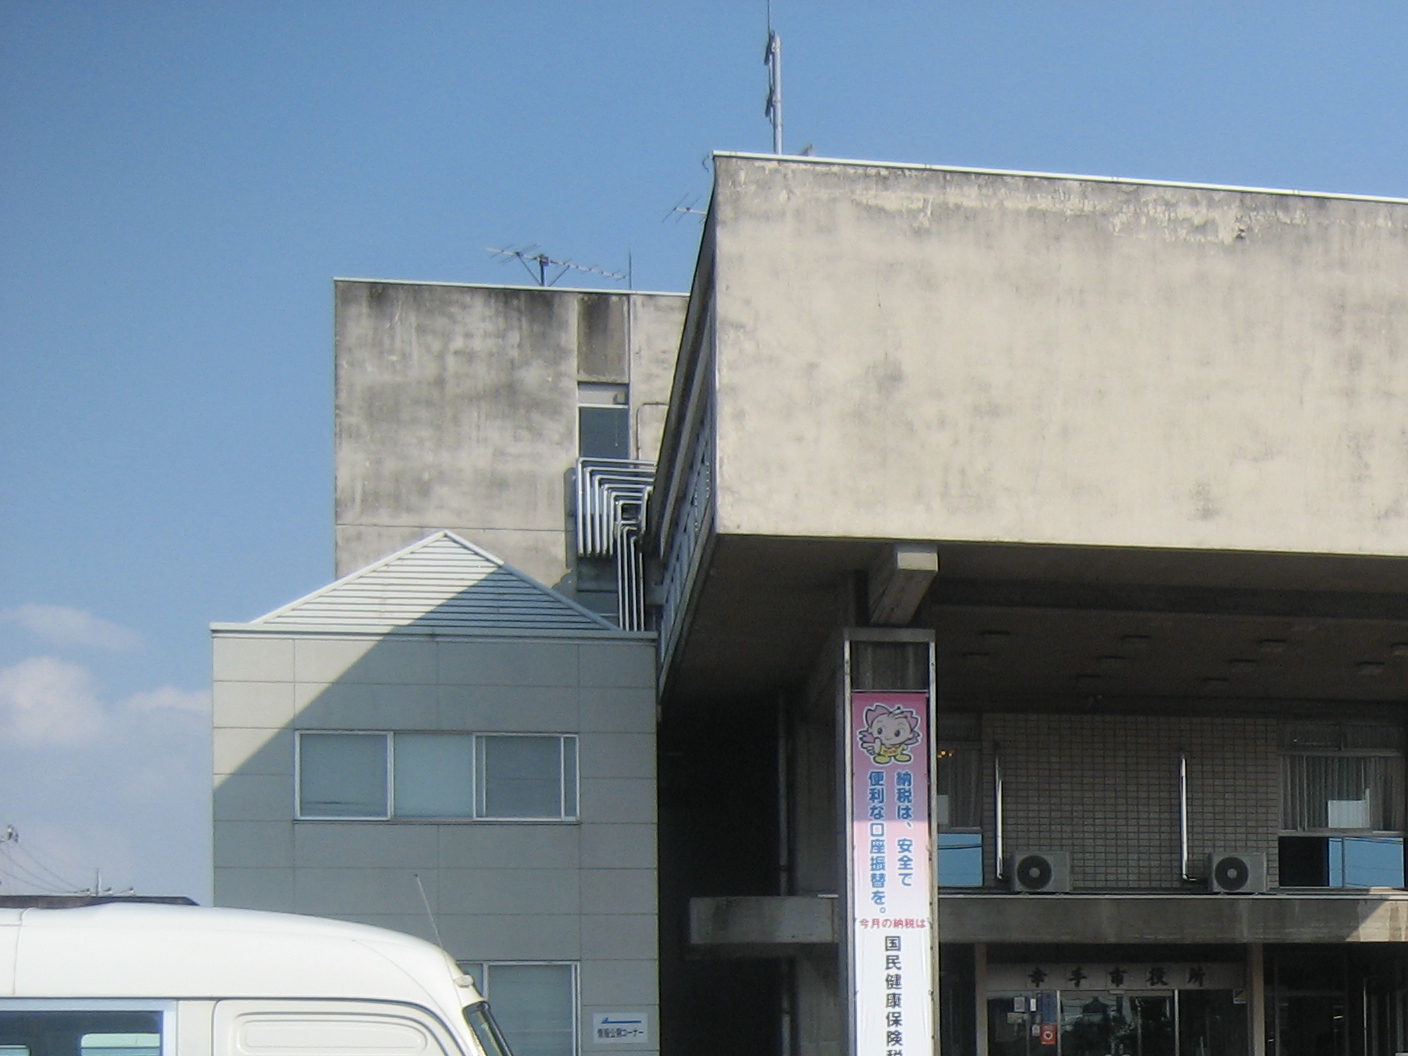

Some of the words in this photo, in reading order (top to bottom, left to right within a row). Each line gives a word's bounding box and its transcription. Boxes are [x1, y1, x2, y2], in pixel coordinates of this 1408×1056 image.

[868, 770, 886, 914] 便利な口座振替を。
[896, 770, 914, 887] 納税は、安全で
[858, 918, 927, 930] 今月の納税は
[1027, 966, 1206, 988] 幸手市役所
